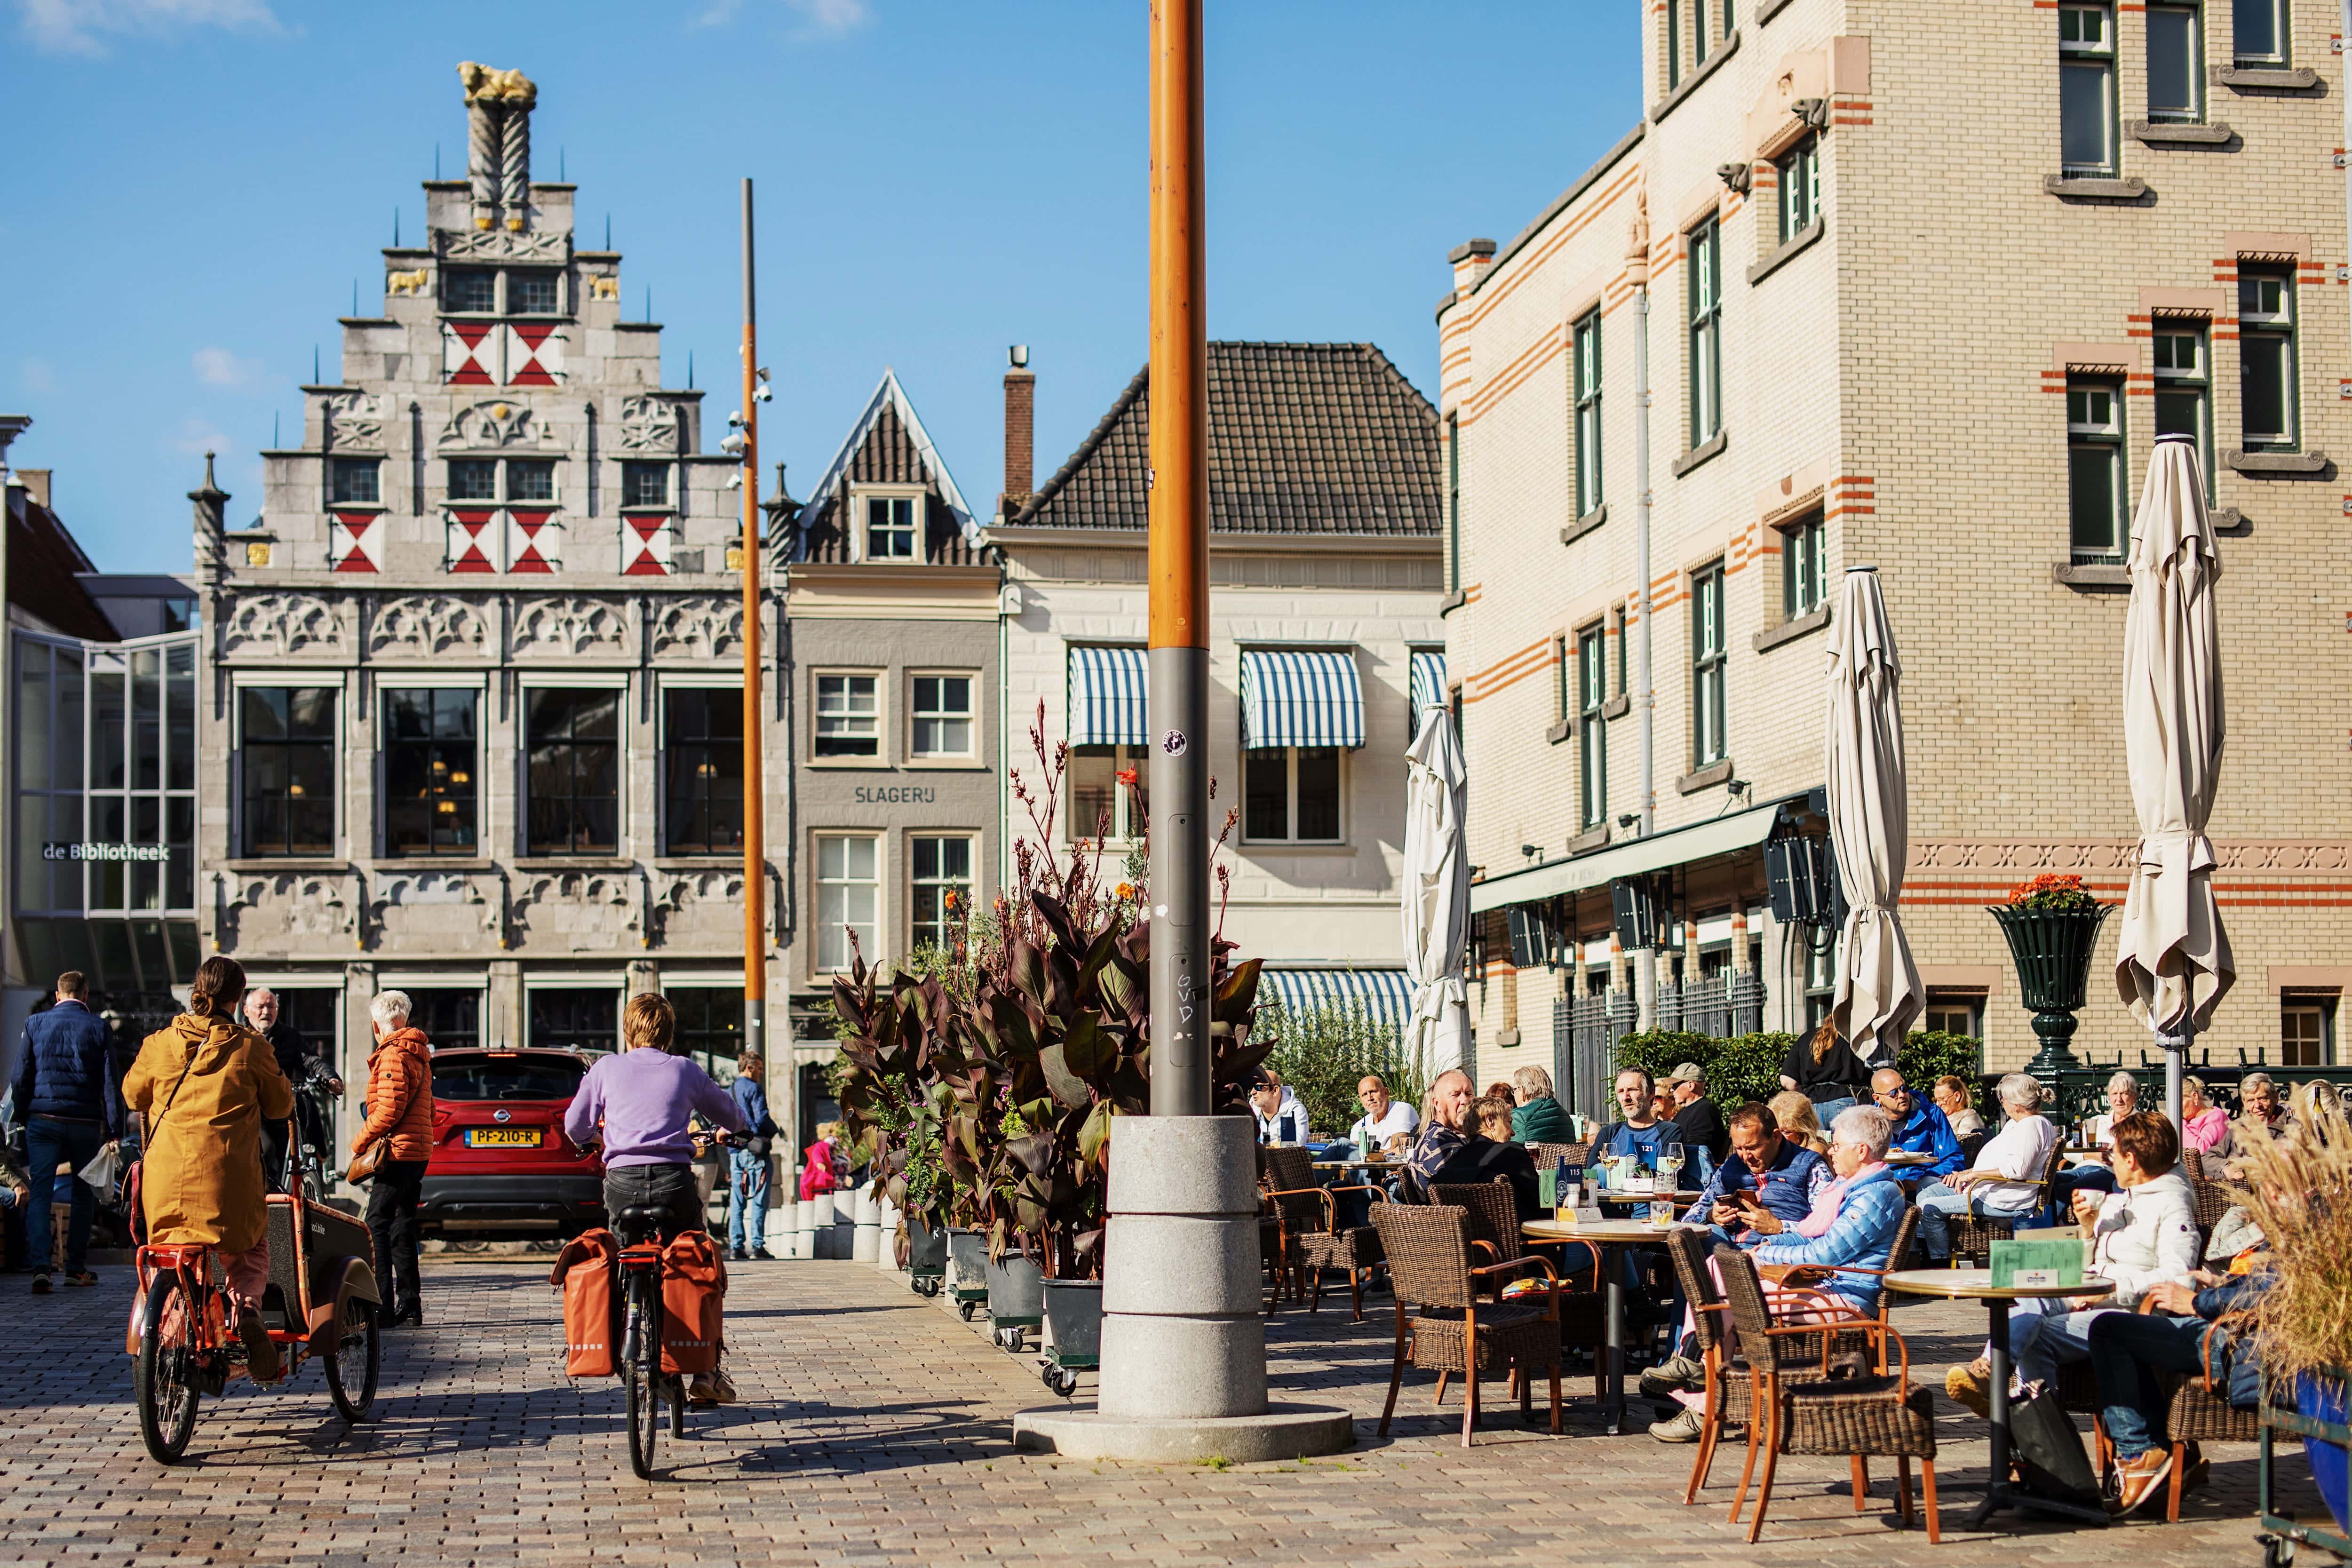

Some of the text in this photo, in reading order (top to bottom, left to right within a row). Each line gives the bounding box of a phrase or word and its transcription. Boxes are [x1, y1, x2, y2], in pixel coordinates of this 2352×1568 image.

[855, 786, 935, 803] SLAGERIJ
[44, 842, 170, 860] de Bibliotheek
[477, 1130, 533, 1142] PF-210-R
[311, 1223, 325, 1235] oci.bike
